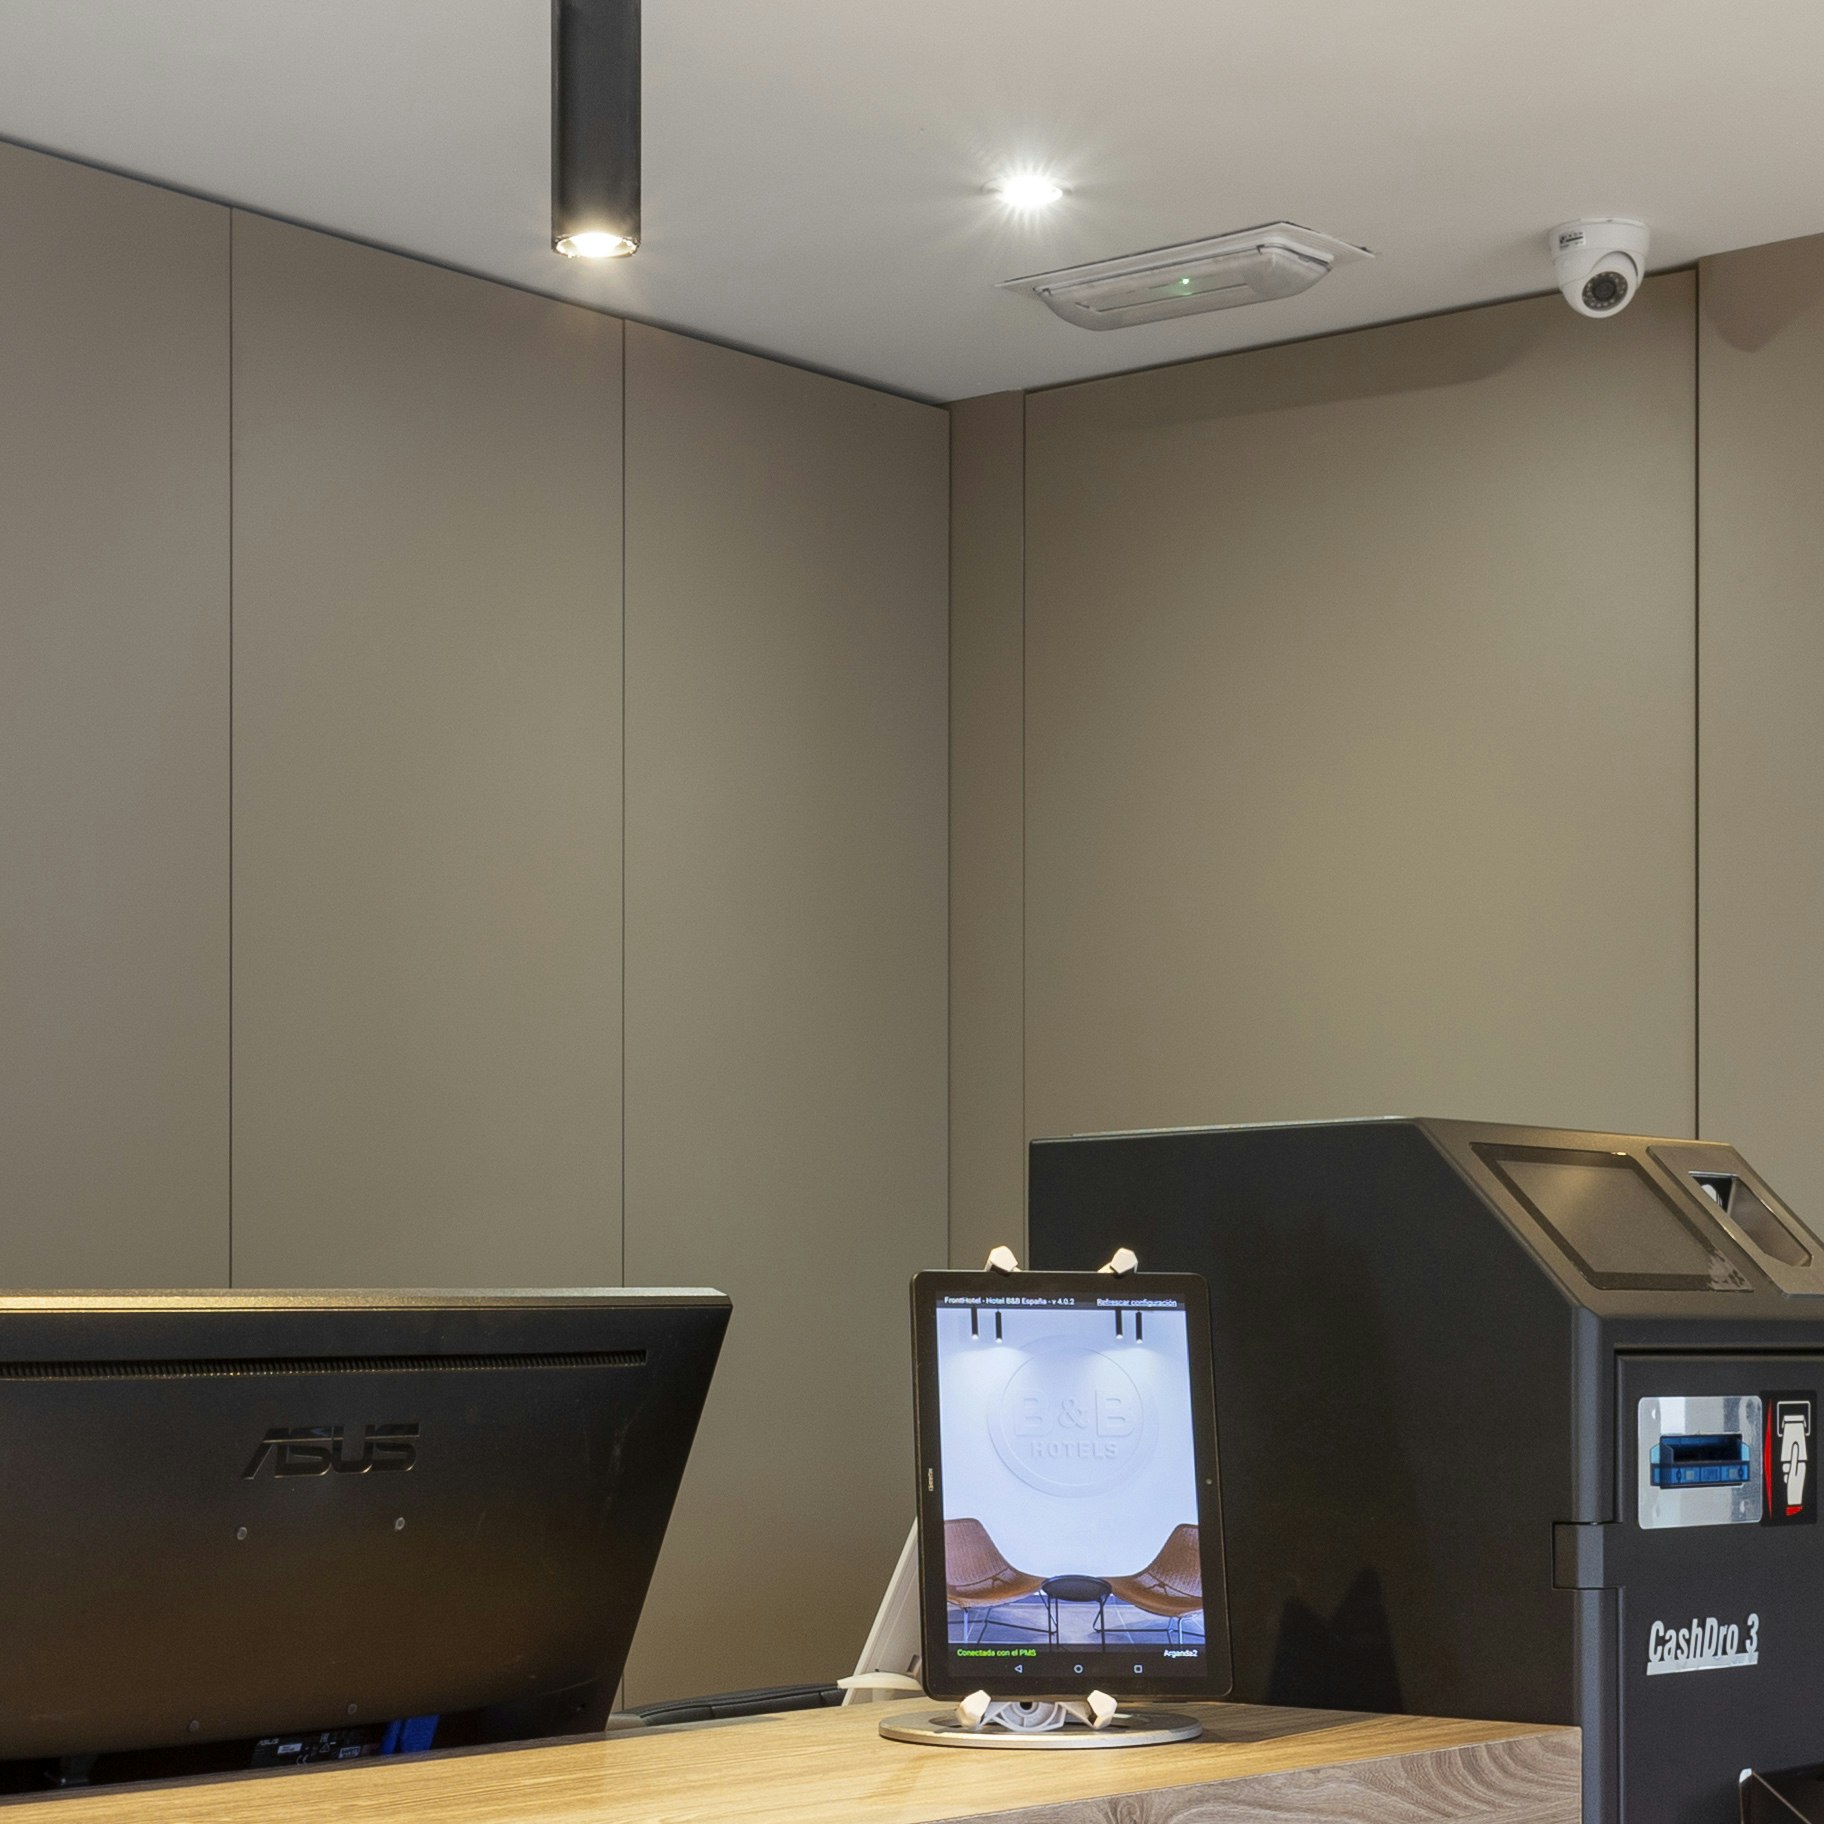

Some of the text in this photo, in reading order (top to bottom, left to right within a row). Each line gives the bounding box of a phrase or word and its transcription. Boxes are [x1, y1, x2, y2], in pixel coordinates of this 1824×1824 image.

[944, 1296, 981, 1304] FrontHotel
[1006, 1297, 1020, 1305] B&B
[1022, 1297, 1047, 1306] España
[1014, 1388, 1136, 1437] B&B
[242, 1423, 420, 1480] ASUS
[1030, 1441, 1117, 1459] HOTELS
[1011, 1648, 1018, 1656] el
[1019, 1648, 1036, 1657] PMS
[1649, 1613, 1759, 1662] CashDro 3
